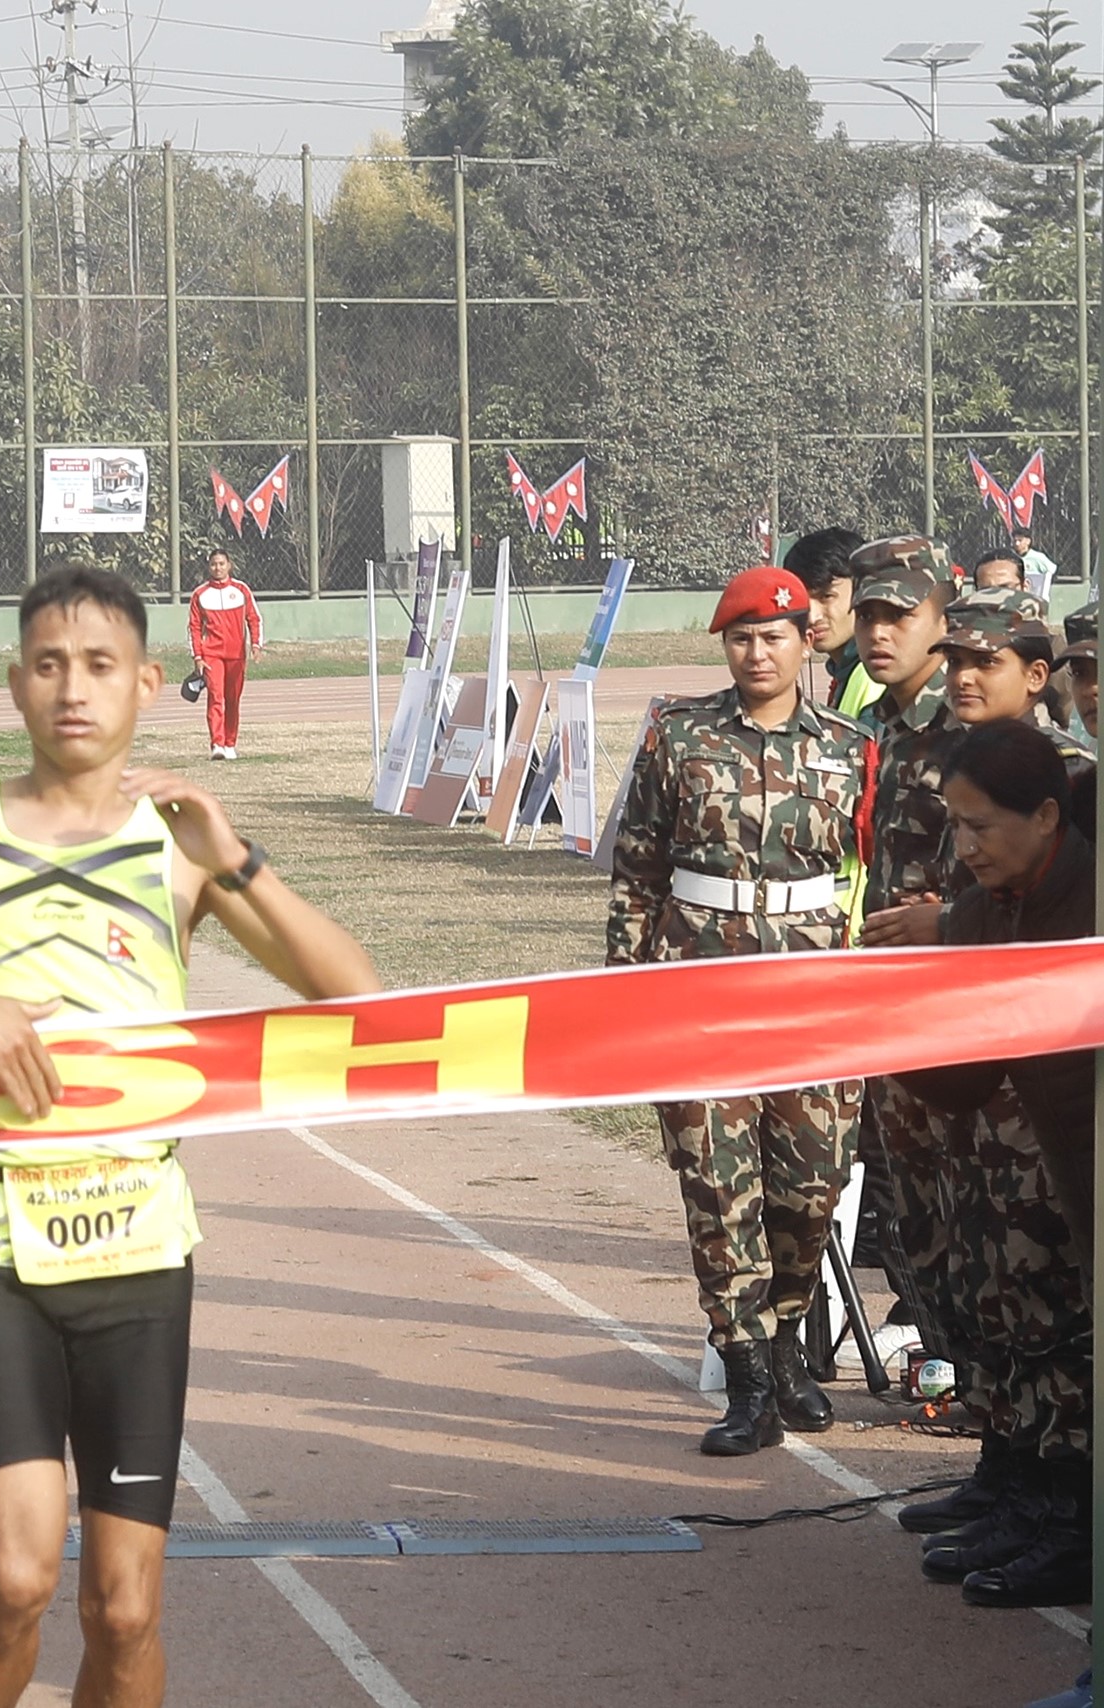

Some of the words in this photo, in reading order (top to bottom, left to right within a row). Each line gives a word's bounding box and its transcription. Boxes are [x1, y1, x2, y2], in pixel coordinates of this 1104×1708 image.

[26, 1188, 81, 1206] 42.195
[86, 1184, 110, 1200] KM
[114, 1177, 148, 1195] RUN
[46, 1205, 137, 1249] 0007
